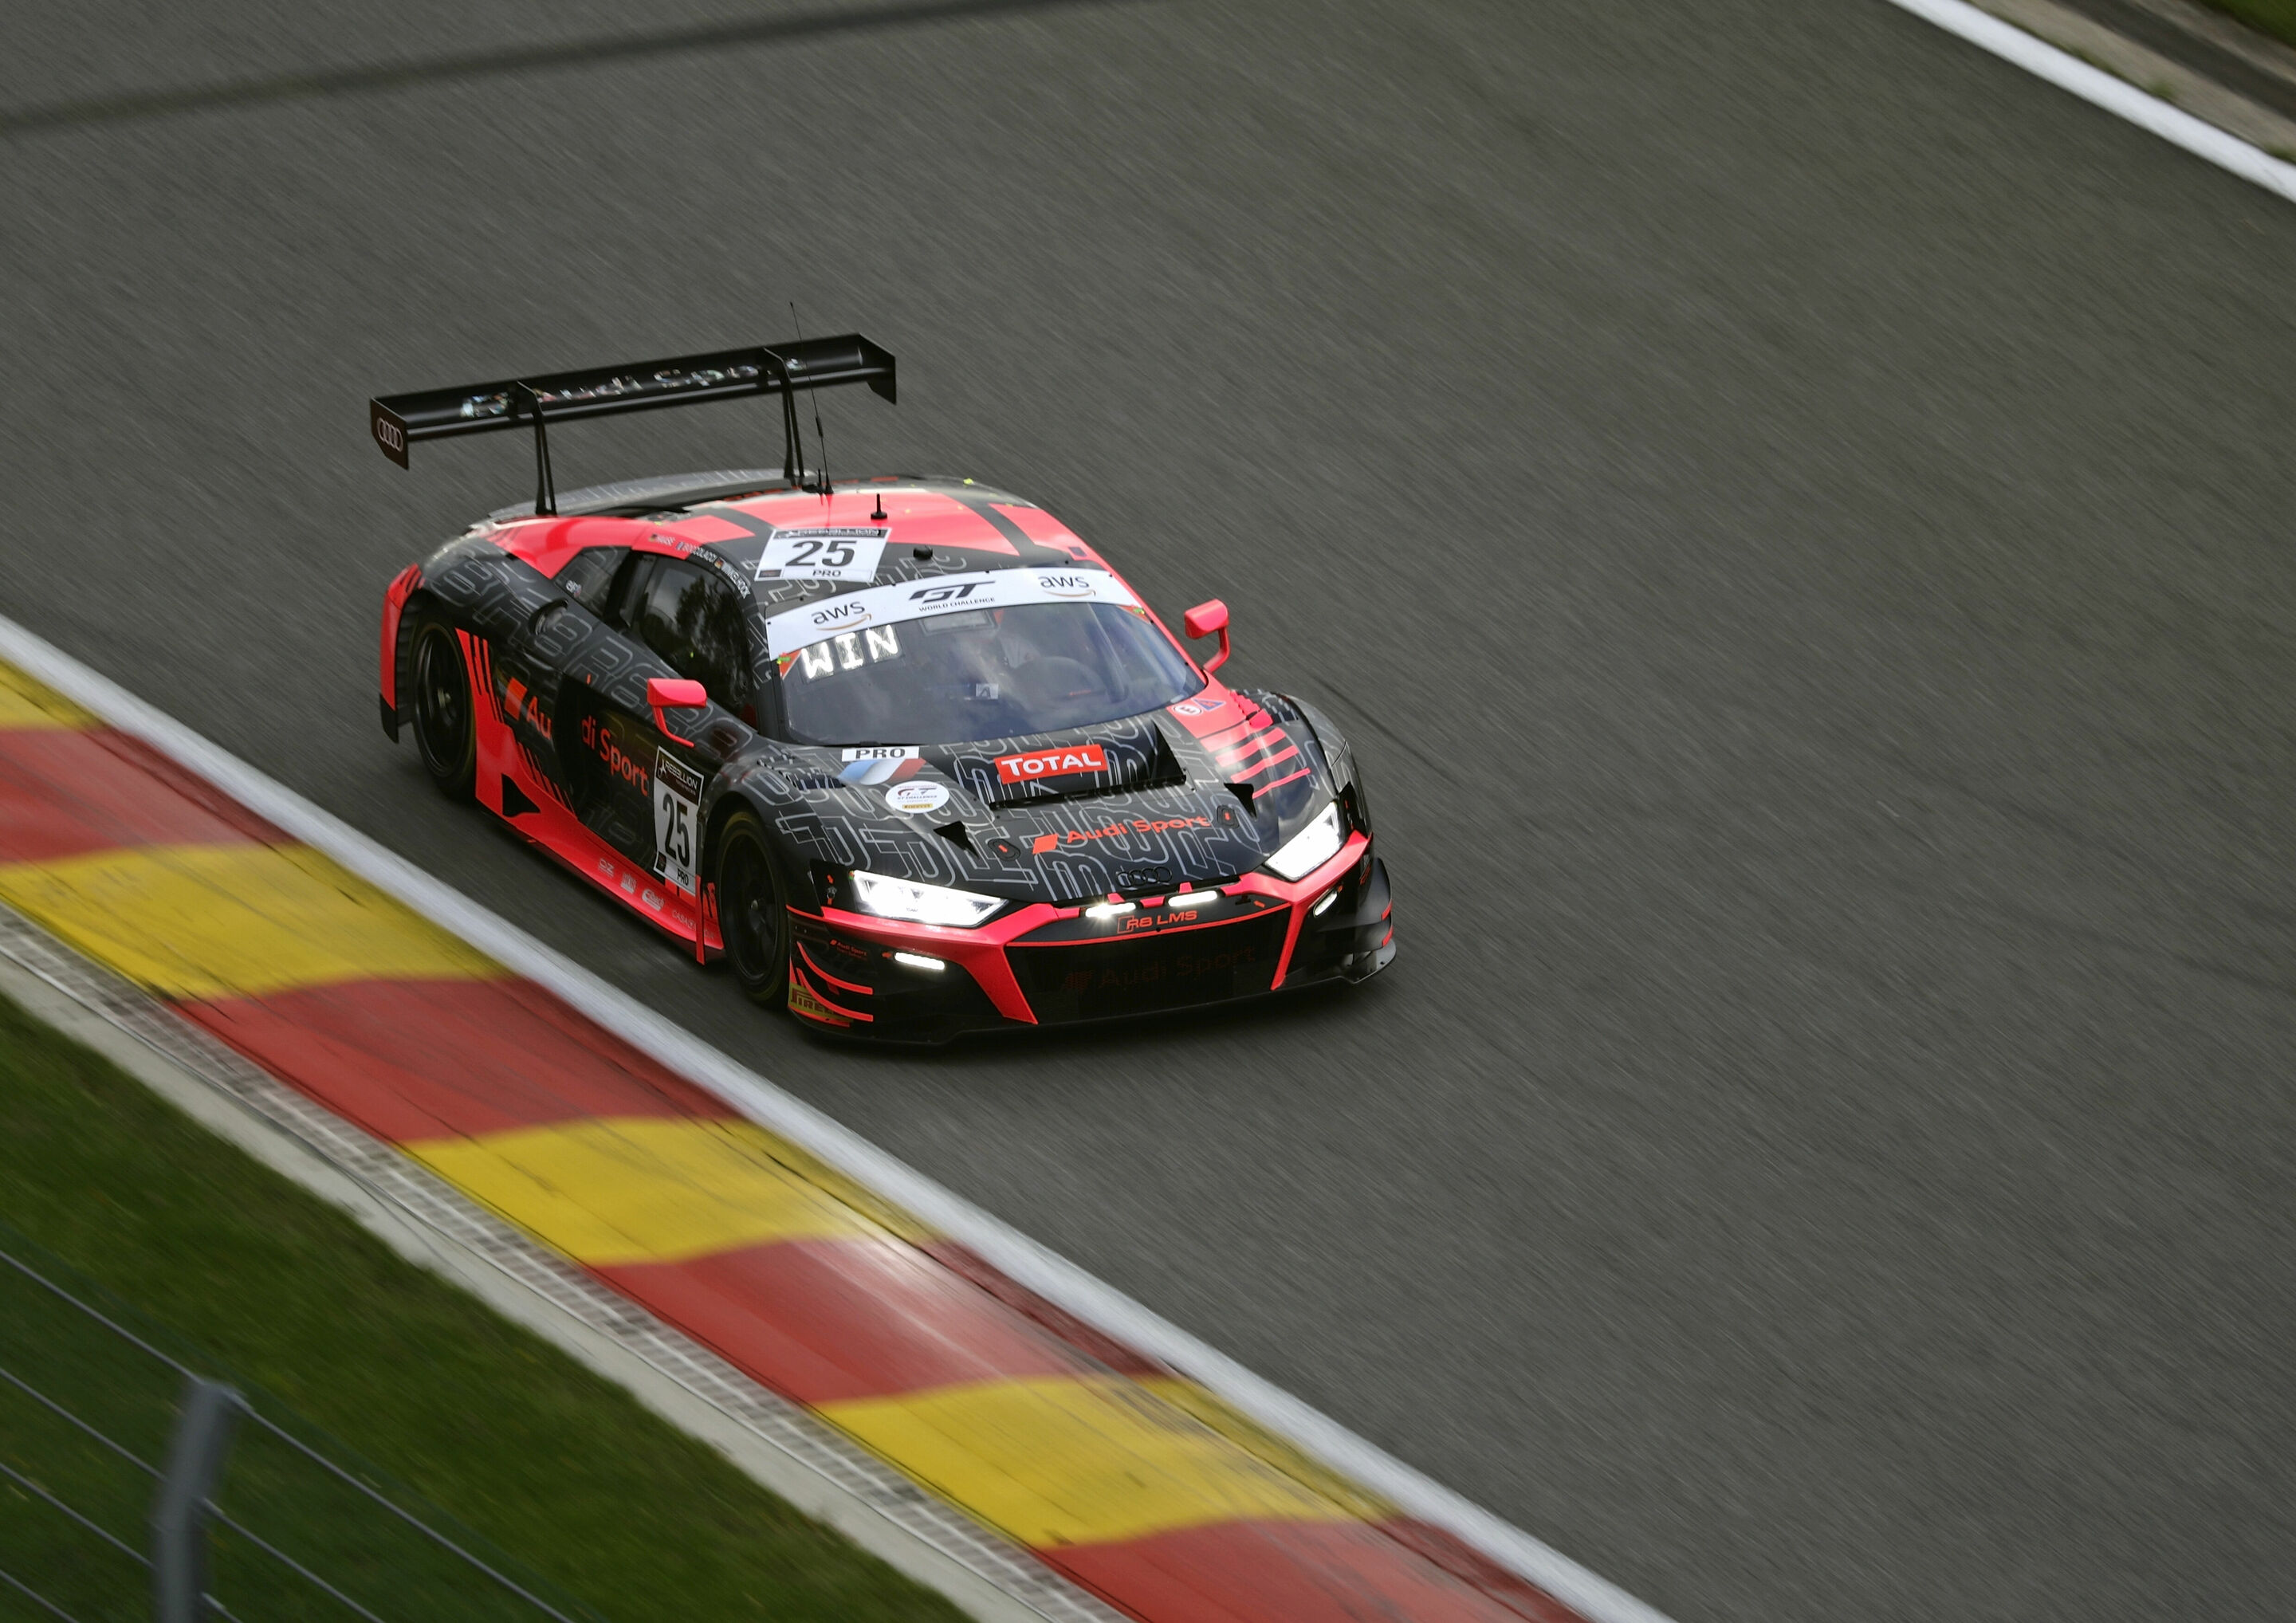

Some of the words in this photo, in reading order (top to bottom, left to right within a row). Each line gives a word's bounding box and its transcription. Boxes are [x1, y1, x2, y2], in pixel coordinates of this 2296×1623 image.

[784, 540, 858, 568] 25
[812, 568, 842, 578] PRO
[1037, 575, 1091, 589] aws
[909, 580, 996, 603] GT
[918, 603, 949, 612] WORLD
[949, 597, 996, 607] CHALLENGE
[811, 600, 866, 626] aws
[800, 623, 898, 679] WIN
[599, 727, 649, 797] Sport
[855, 748, 906, 759] PRO
[665, 760, 698, 790] REBELLION
[662, 792, 690, 869] 25
[1067, 823, 1128, 844] Audi
[1131, 815, 1211, 834] Sport
[677, 867, 689, 886] PRO
[1126, 917, 1153, 931] R8
[1157, 910, 1198, 925] LMS
[1098, 960, 1167, 989] Audi
[1175, 945, 1256, 980] Sport
